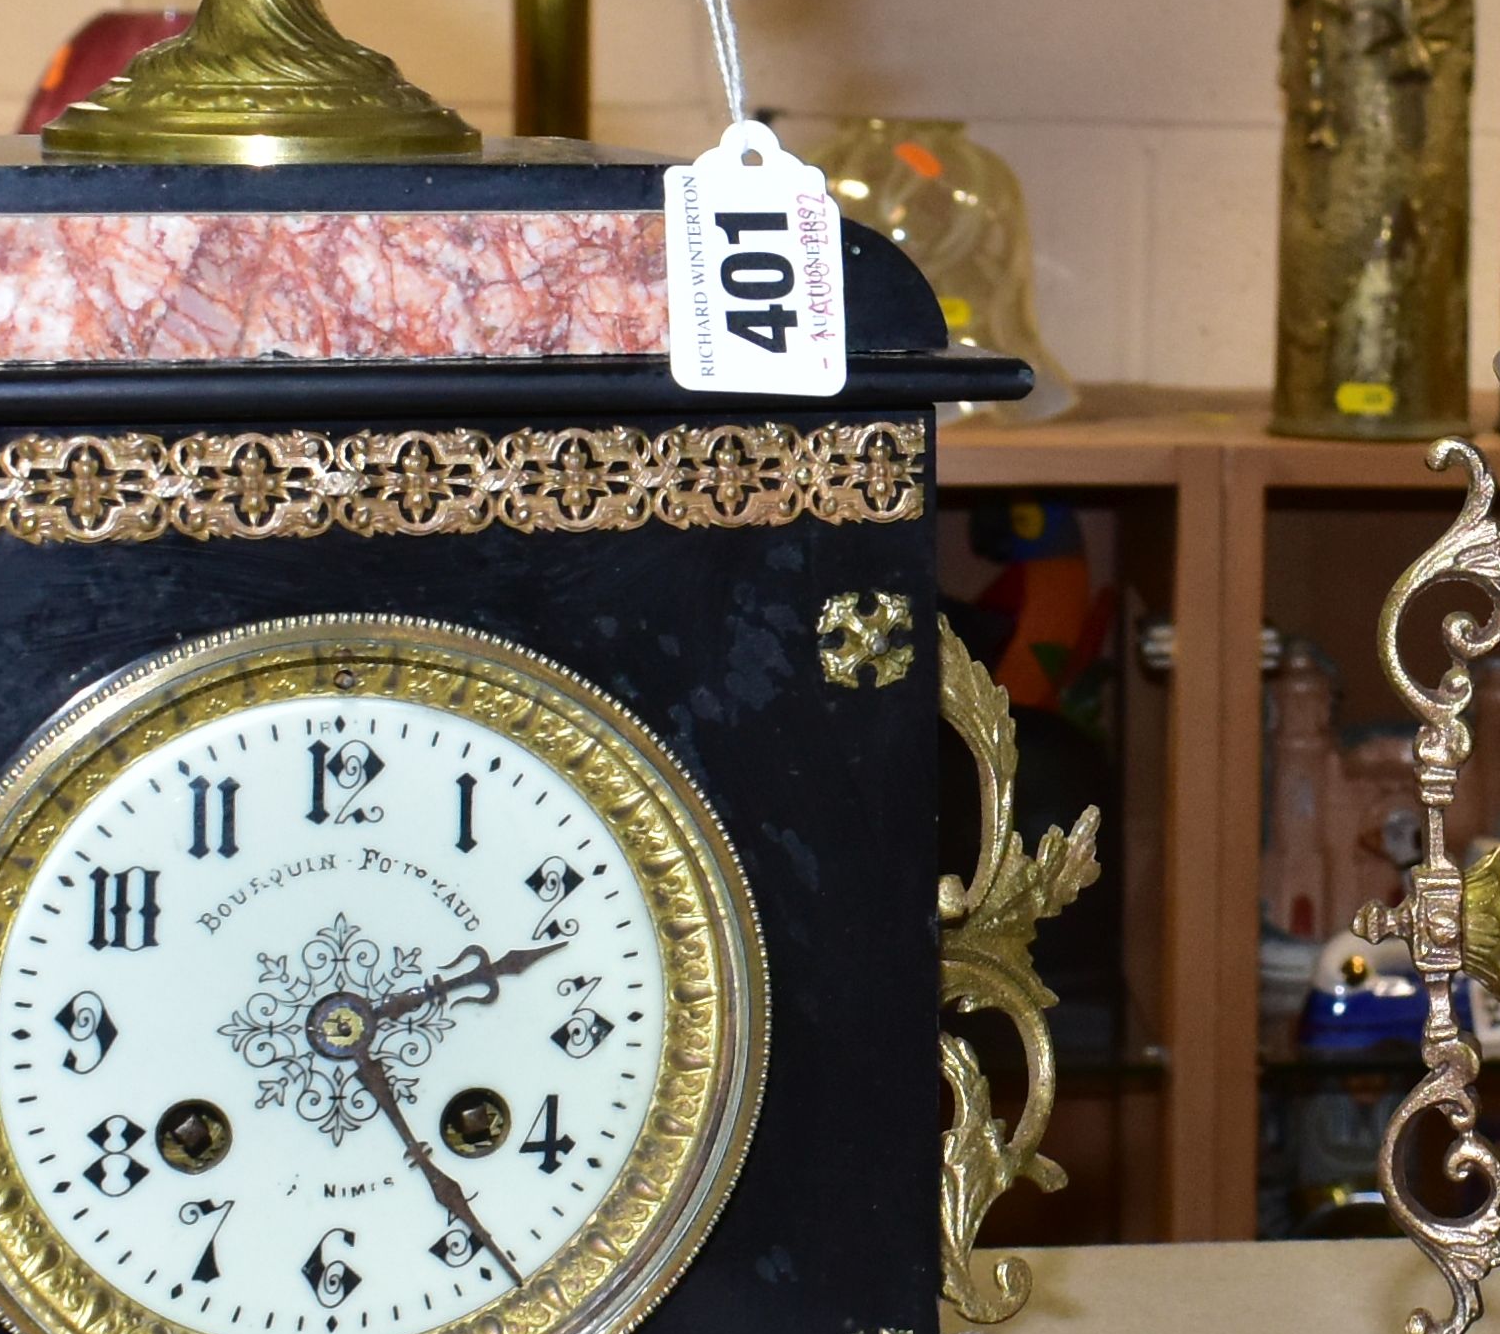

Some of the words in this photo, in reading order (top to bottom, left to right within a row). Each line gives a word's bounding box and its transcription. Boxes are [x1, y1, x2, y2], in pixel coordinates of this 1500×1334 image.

[682, 175, 706, 286] WINTERTON
[714, 212, 798, 353] 401
[693, 291, 716, 377] RICHARD
[187, 775, 241, 860] 11
[304, 739, 386, 826] 12
[454, 772, 479, 854] 1
[87, 865, 162, 952] 10
[524, 855, 582, 941] 2
[54, 991, 119, 1075] 9
[549, 976, 616, 1060] 3
[82, 1114, 151, 1198] 8
[518, 1093, 577, 1175] 4
[178, 1198, 236, 1285] 7
[301, 1227, 363, 1310] 6
